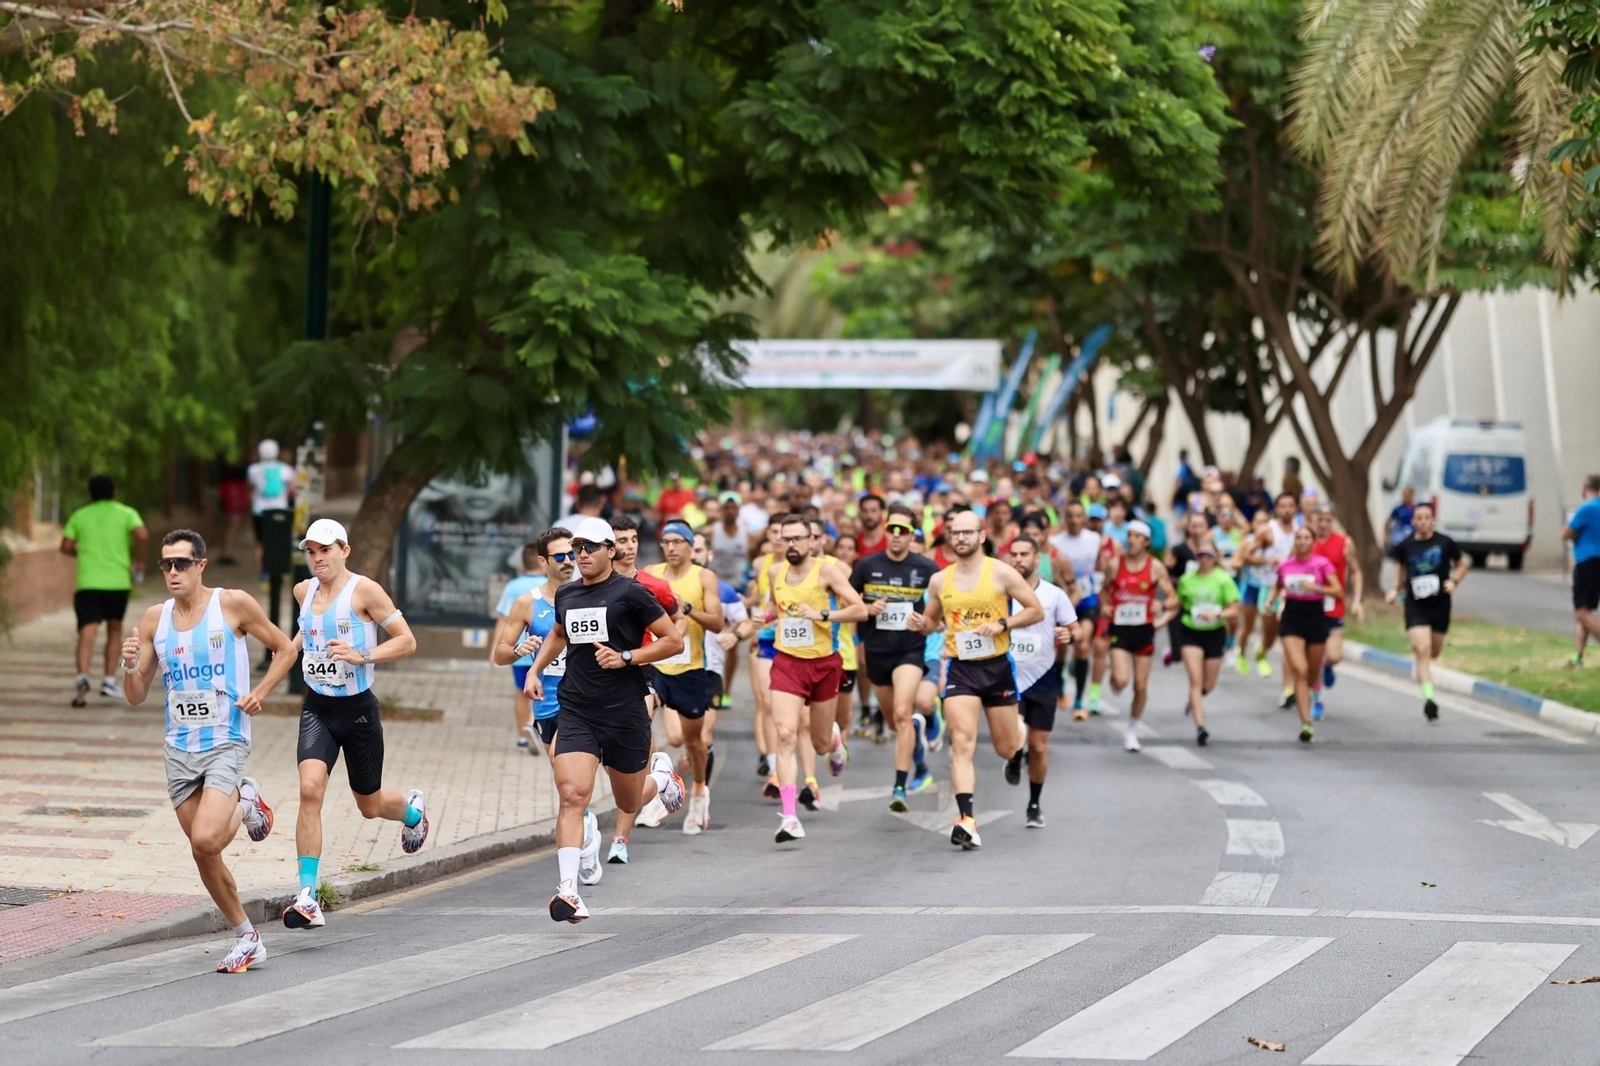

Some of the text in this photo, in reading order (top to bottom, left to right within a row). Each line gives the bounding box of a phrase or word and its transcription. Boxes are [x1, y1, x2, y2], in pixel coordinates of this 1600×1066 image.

[881, 612, 906, 622] 847
[571, 620, 599, 633] 859
[784, 628, 807, 638] 692
[965, 639, 983, 651] 33
[1011, 643, 1035, 653] 790
[163, 662, 225, 685] málaga
[307, 662, 338, 676] 344
[176, 702, 210, 716] 125
